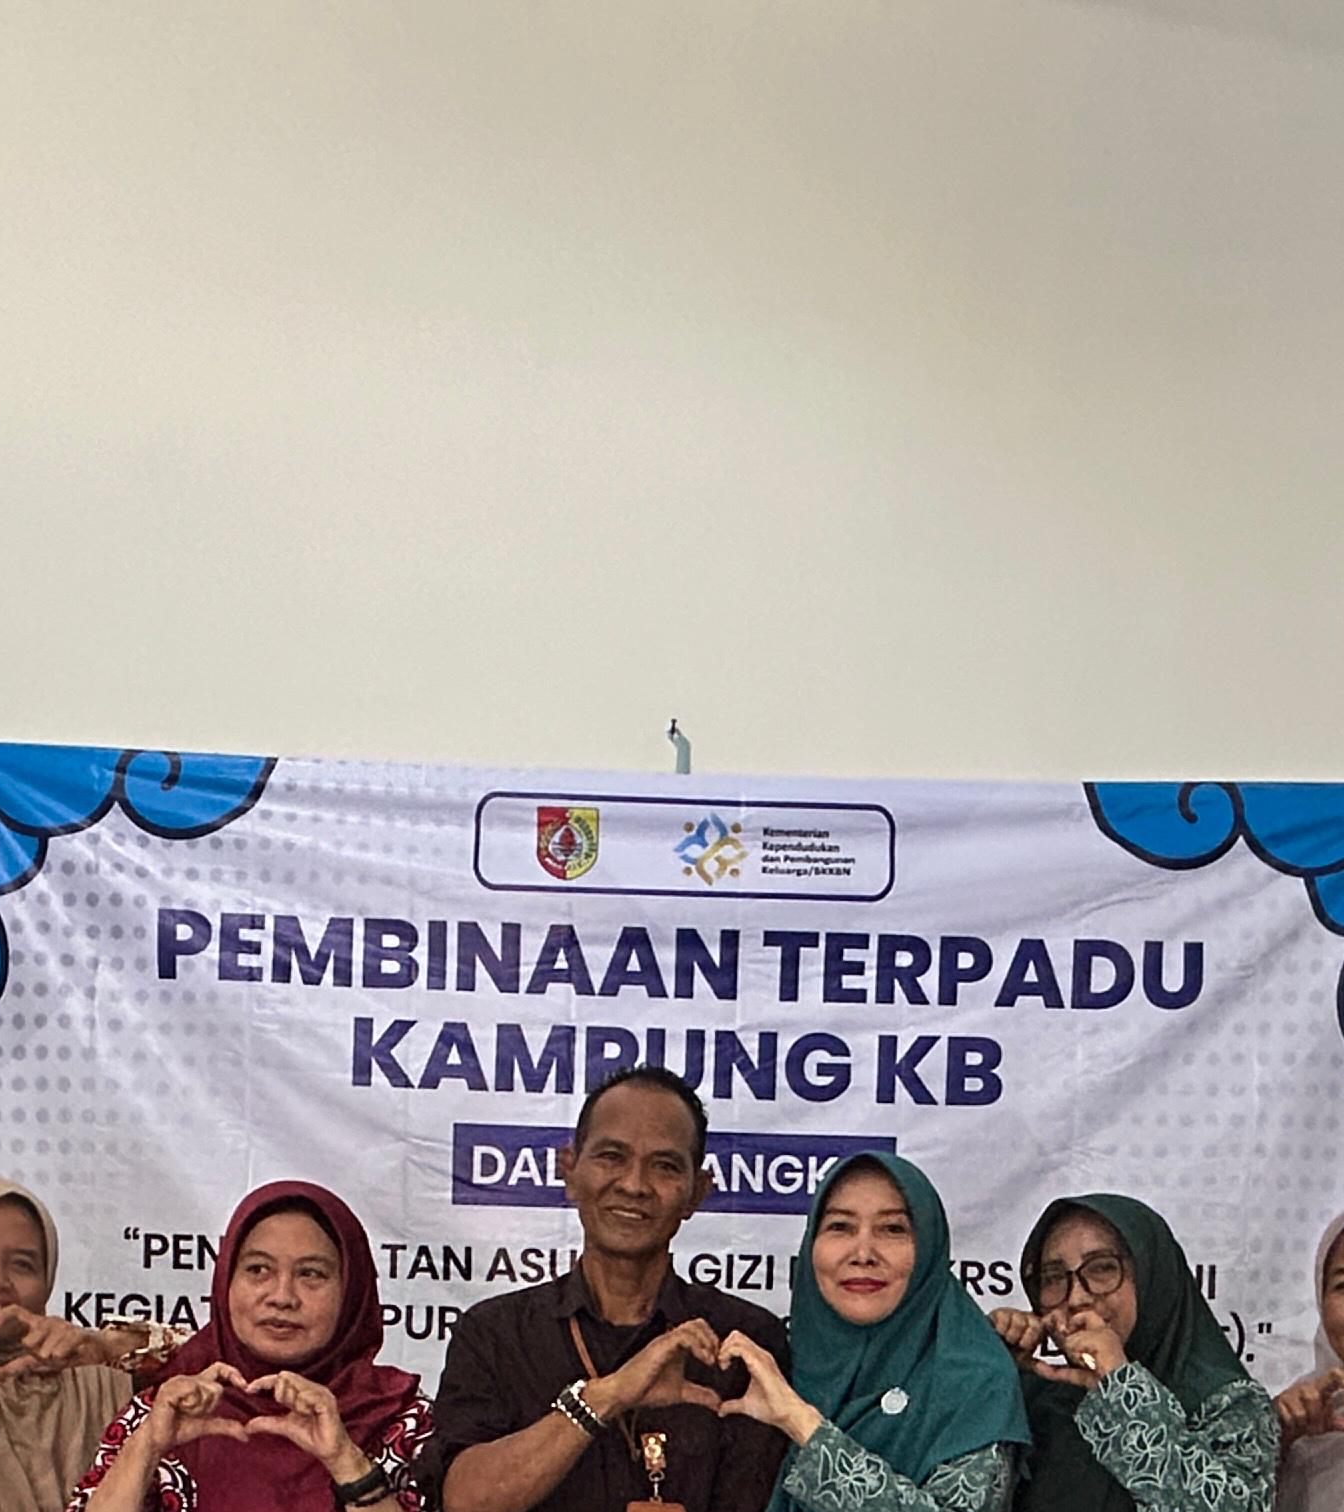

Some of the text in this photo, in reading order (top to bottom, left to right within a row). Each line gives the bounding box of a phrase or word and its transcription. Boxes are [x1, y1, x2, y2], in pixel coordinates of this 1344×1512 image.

[157, 908, 1204, 1010] PEMBINAAN TERPADU
[352, 1016, 1003, 1106] KAMPUNG KB
[472, 1145, 839, 1195] DAL ANGK
[688, 1253, 774, 1290] GIZI
